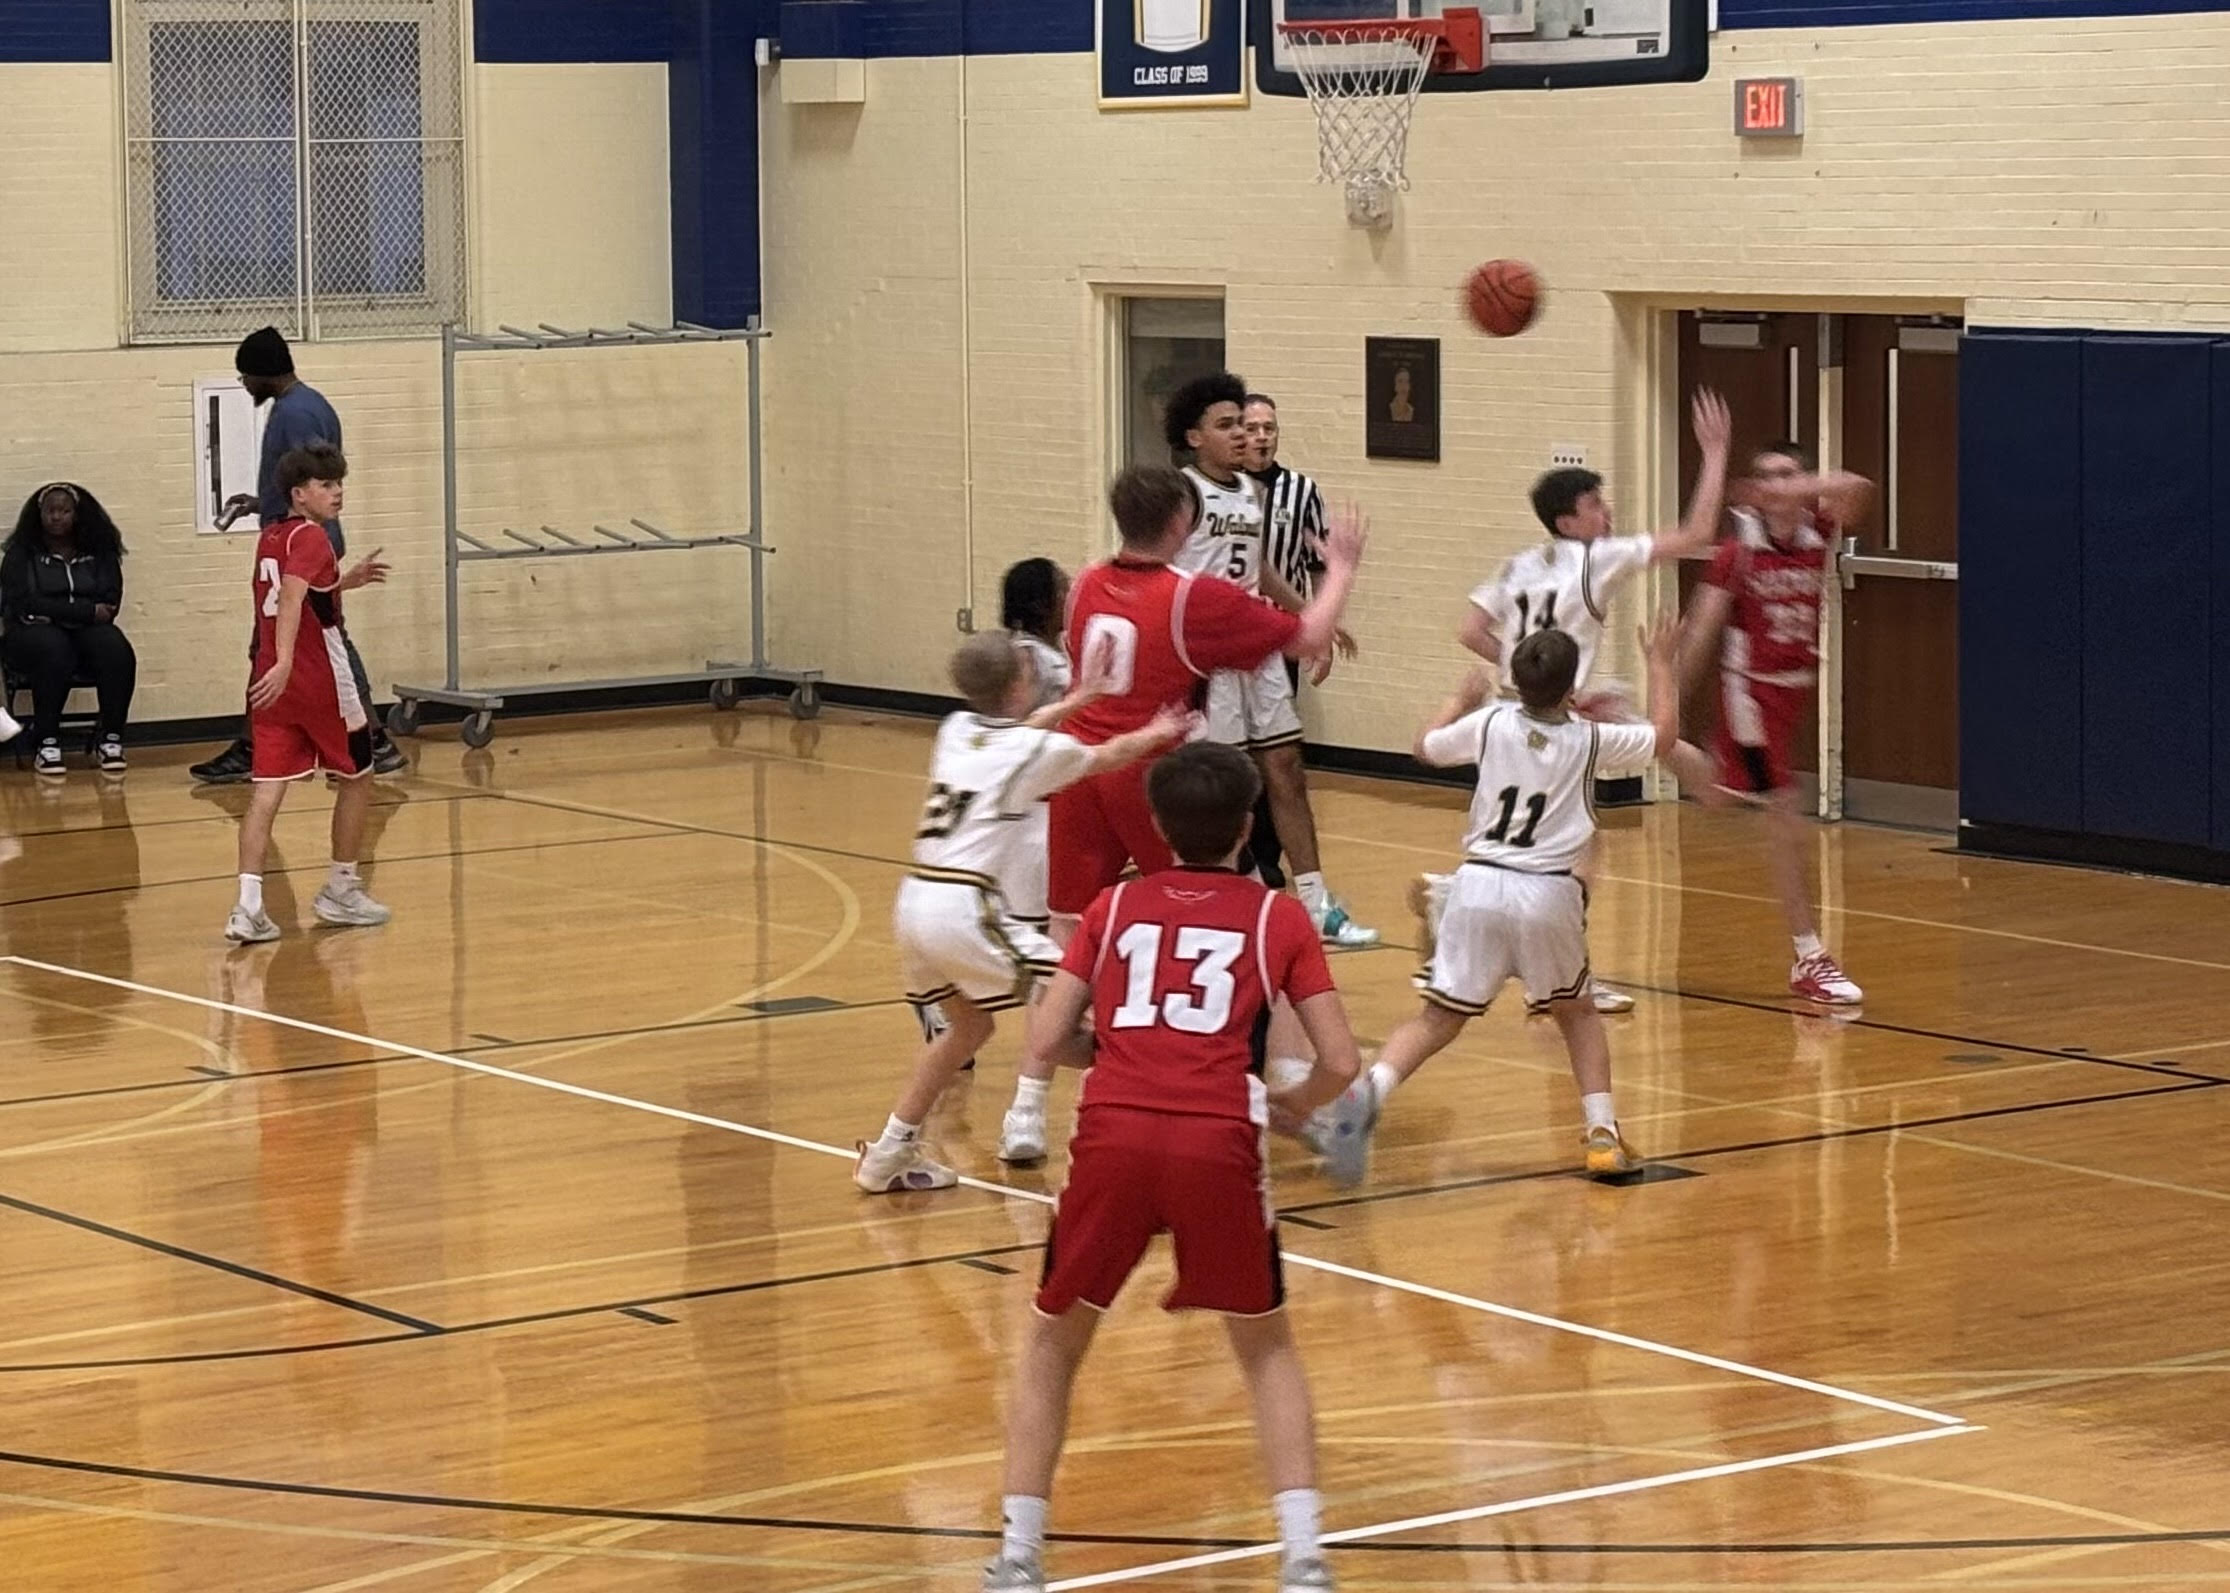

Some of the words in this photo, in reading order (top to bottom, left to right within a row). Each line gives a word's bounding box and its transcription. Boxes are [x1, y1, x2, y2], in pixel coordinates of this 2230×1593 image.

[1134, 66, 1168, 86] CLASS
[1170, 65, 1184, 84] OF
[1744, 83, 1786, 129] EXIT
[259, 557, 281, 617] 2
[1228, 543, 1247, 579] 5
[1080, 612, 1138, 695] 0
[1485, 784, 1547, 848] 11
[1111, 922, 1247, 1035] 13
